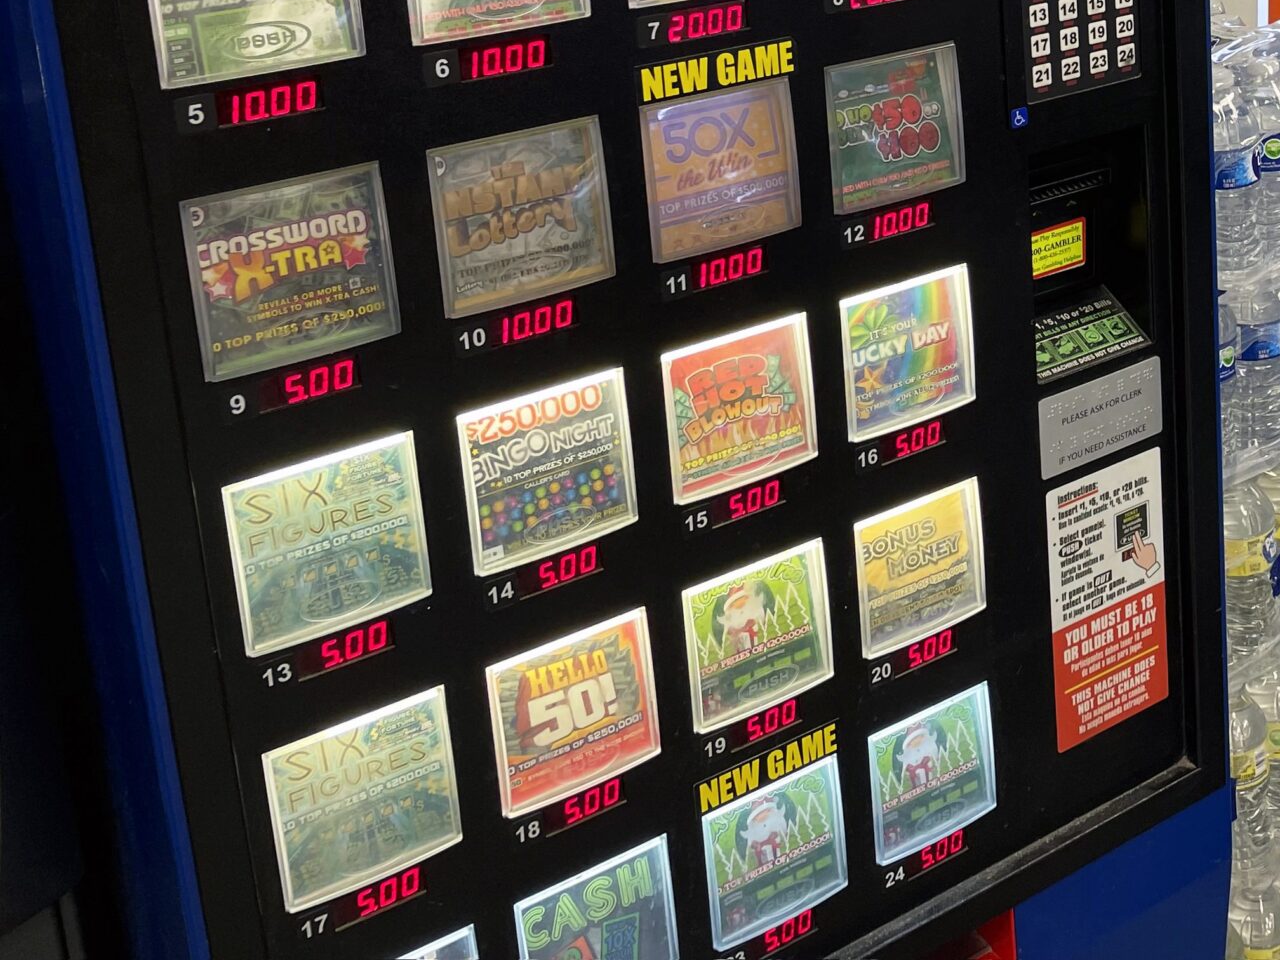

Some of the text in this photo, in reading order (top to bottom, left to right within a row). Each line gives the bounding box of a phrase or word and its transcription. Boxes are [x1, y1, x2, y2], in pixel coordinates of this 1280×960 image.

[648, 22, 660, 40] 7
[435, 59, 449, 77] 6
[640, 41, 794, 102] NEW GAME
[1035, 49, 1134, 82] 21 22 23 24
[188, 105, 204, 124] 5
[663, 107, 754, 164] 50X
[676, 152, 753, 191] the Win
[197, 210, 367, 268] CROSSWORD
[448, 196, 577, 257] Lottery
[844, 225, 864, 243] 12
[229, 240, 343, 304] X-TRA
[666, 274, 686, 294] 11
[225, 335, 252, 350] TOP
[256, 323, 298, 342] PRIZES
[303, 319, 319, 332] OF
[459, 328, 486, 350] 10
[912, 322, 950, 351] DAY
[230, 395, 246, 414] 9
[684, 396, 782, 443] BLOWOUT
[1062, 388, 1143, 426] PLEASE ASK FOR CLERK
[473, 413, 615, 487] BINGO NIGHT
[858, 449, 878, 467] 16
[1059, 423, 1147, 465] IF YOU NEED ASSISTANCE
[245, 471, 328, 524] SIX
[247, 494, 394, 558] FIGURES
[685, 511, 708, 532] 15
[886, 531, 963, 580] MONEY
[488, 581, 514, 604] 14
[1064, 646, 1079, 664] OR
[1082, 630, 1114, 656] OLDER
[1117, 622, 1130, 638] TO
[1132, 607, 1157, 631] PLAY
[1065, 593, 1154, 647] YOU MUST BE 18
[263, 663, 292, 687] 13
[525, 649, 608, 698] HELLO
[872, 663, 891, 684] 20
[1072, 655, 1155, 706] THIS MACHINE DOES
[1078, 670, 1150, 715] NOT GIVE CHANGE
[527, 672, 617, 748] 50!
[704, 737, 726, 758] 19
[699, 723, 837, 812] NEW GAME
[515, 821, 540, 843] 18
[885, 866, 905, 888] 24
[523, 856, 654, 949] CASH
[302, 914, 328, 939] 17
